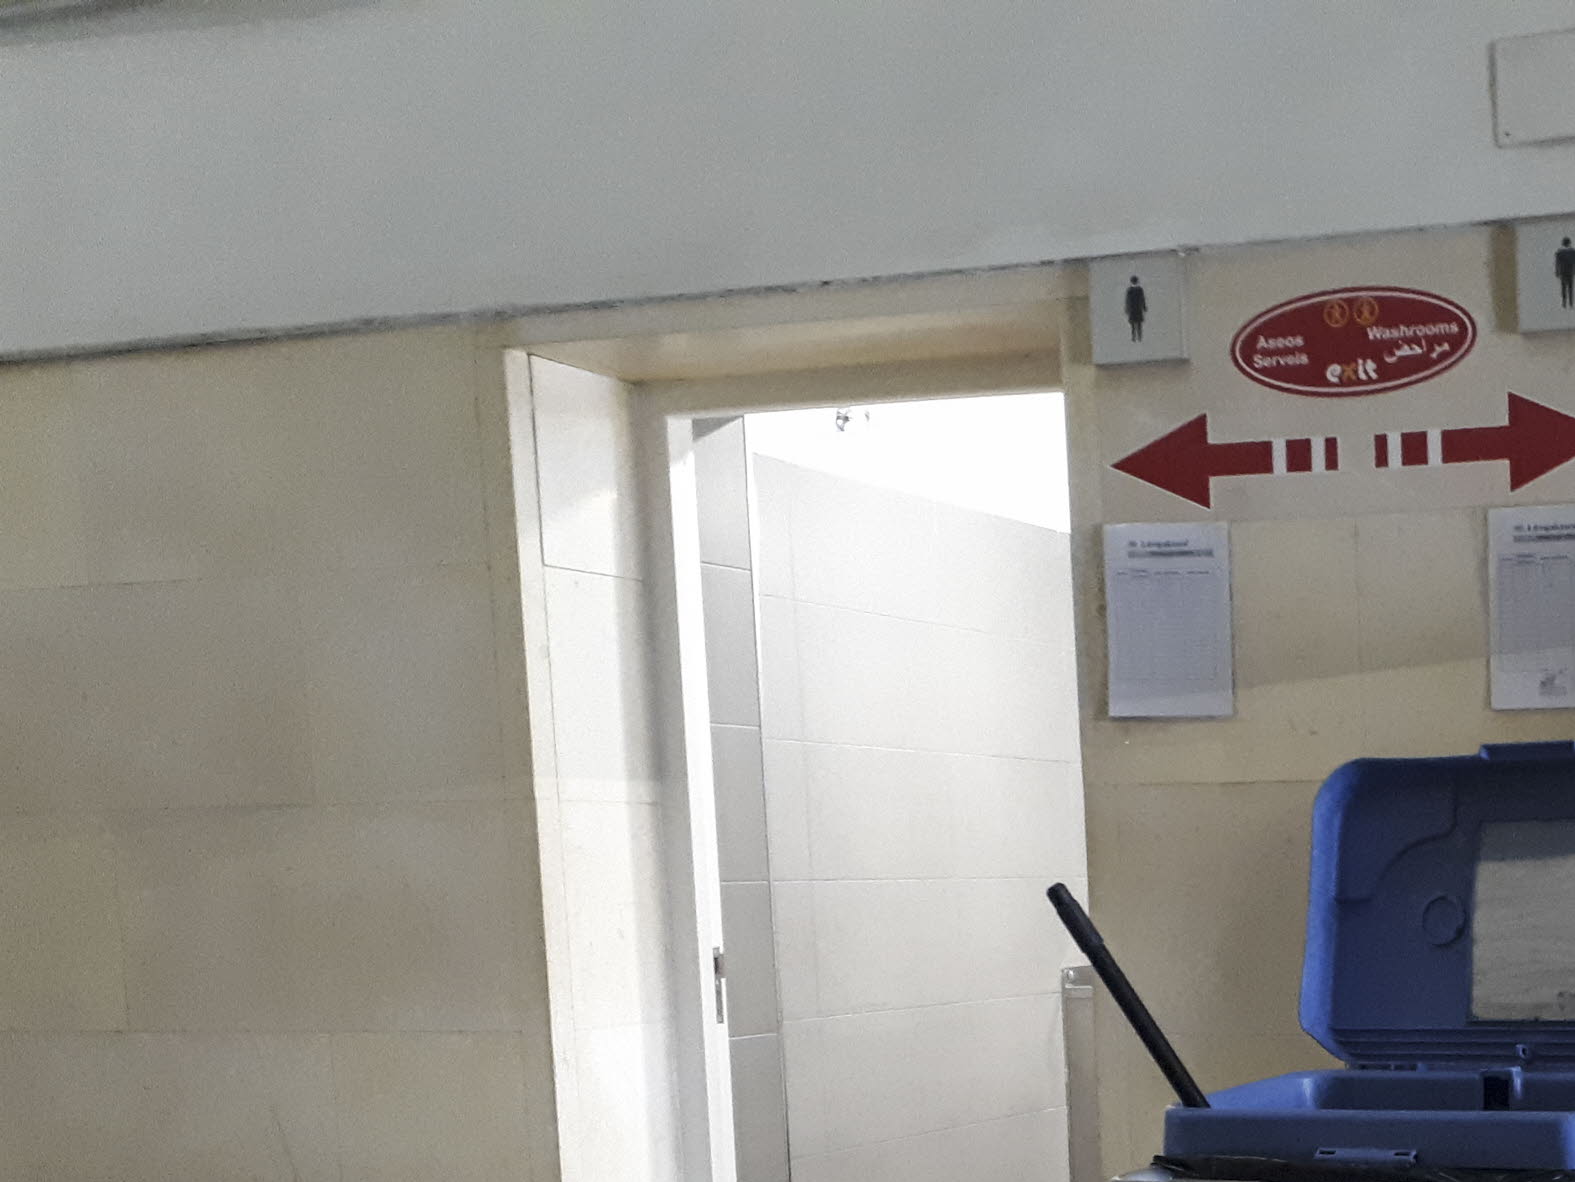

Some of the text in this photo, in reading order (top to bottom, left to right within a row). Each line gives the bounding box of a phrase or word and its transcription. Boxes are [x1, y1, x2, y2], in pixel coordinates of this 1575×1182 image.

[1366, 320, 1459, 341] Washrooms
[1256, 334, 1305, 351] Aseos
[1325, 357, 1379, 384] exit
